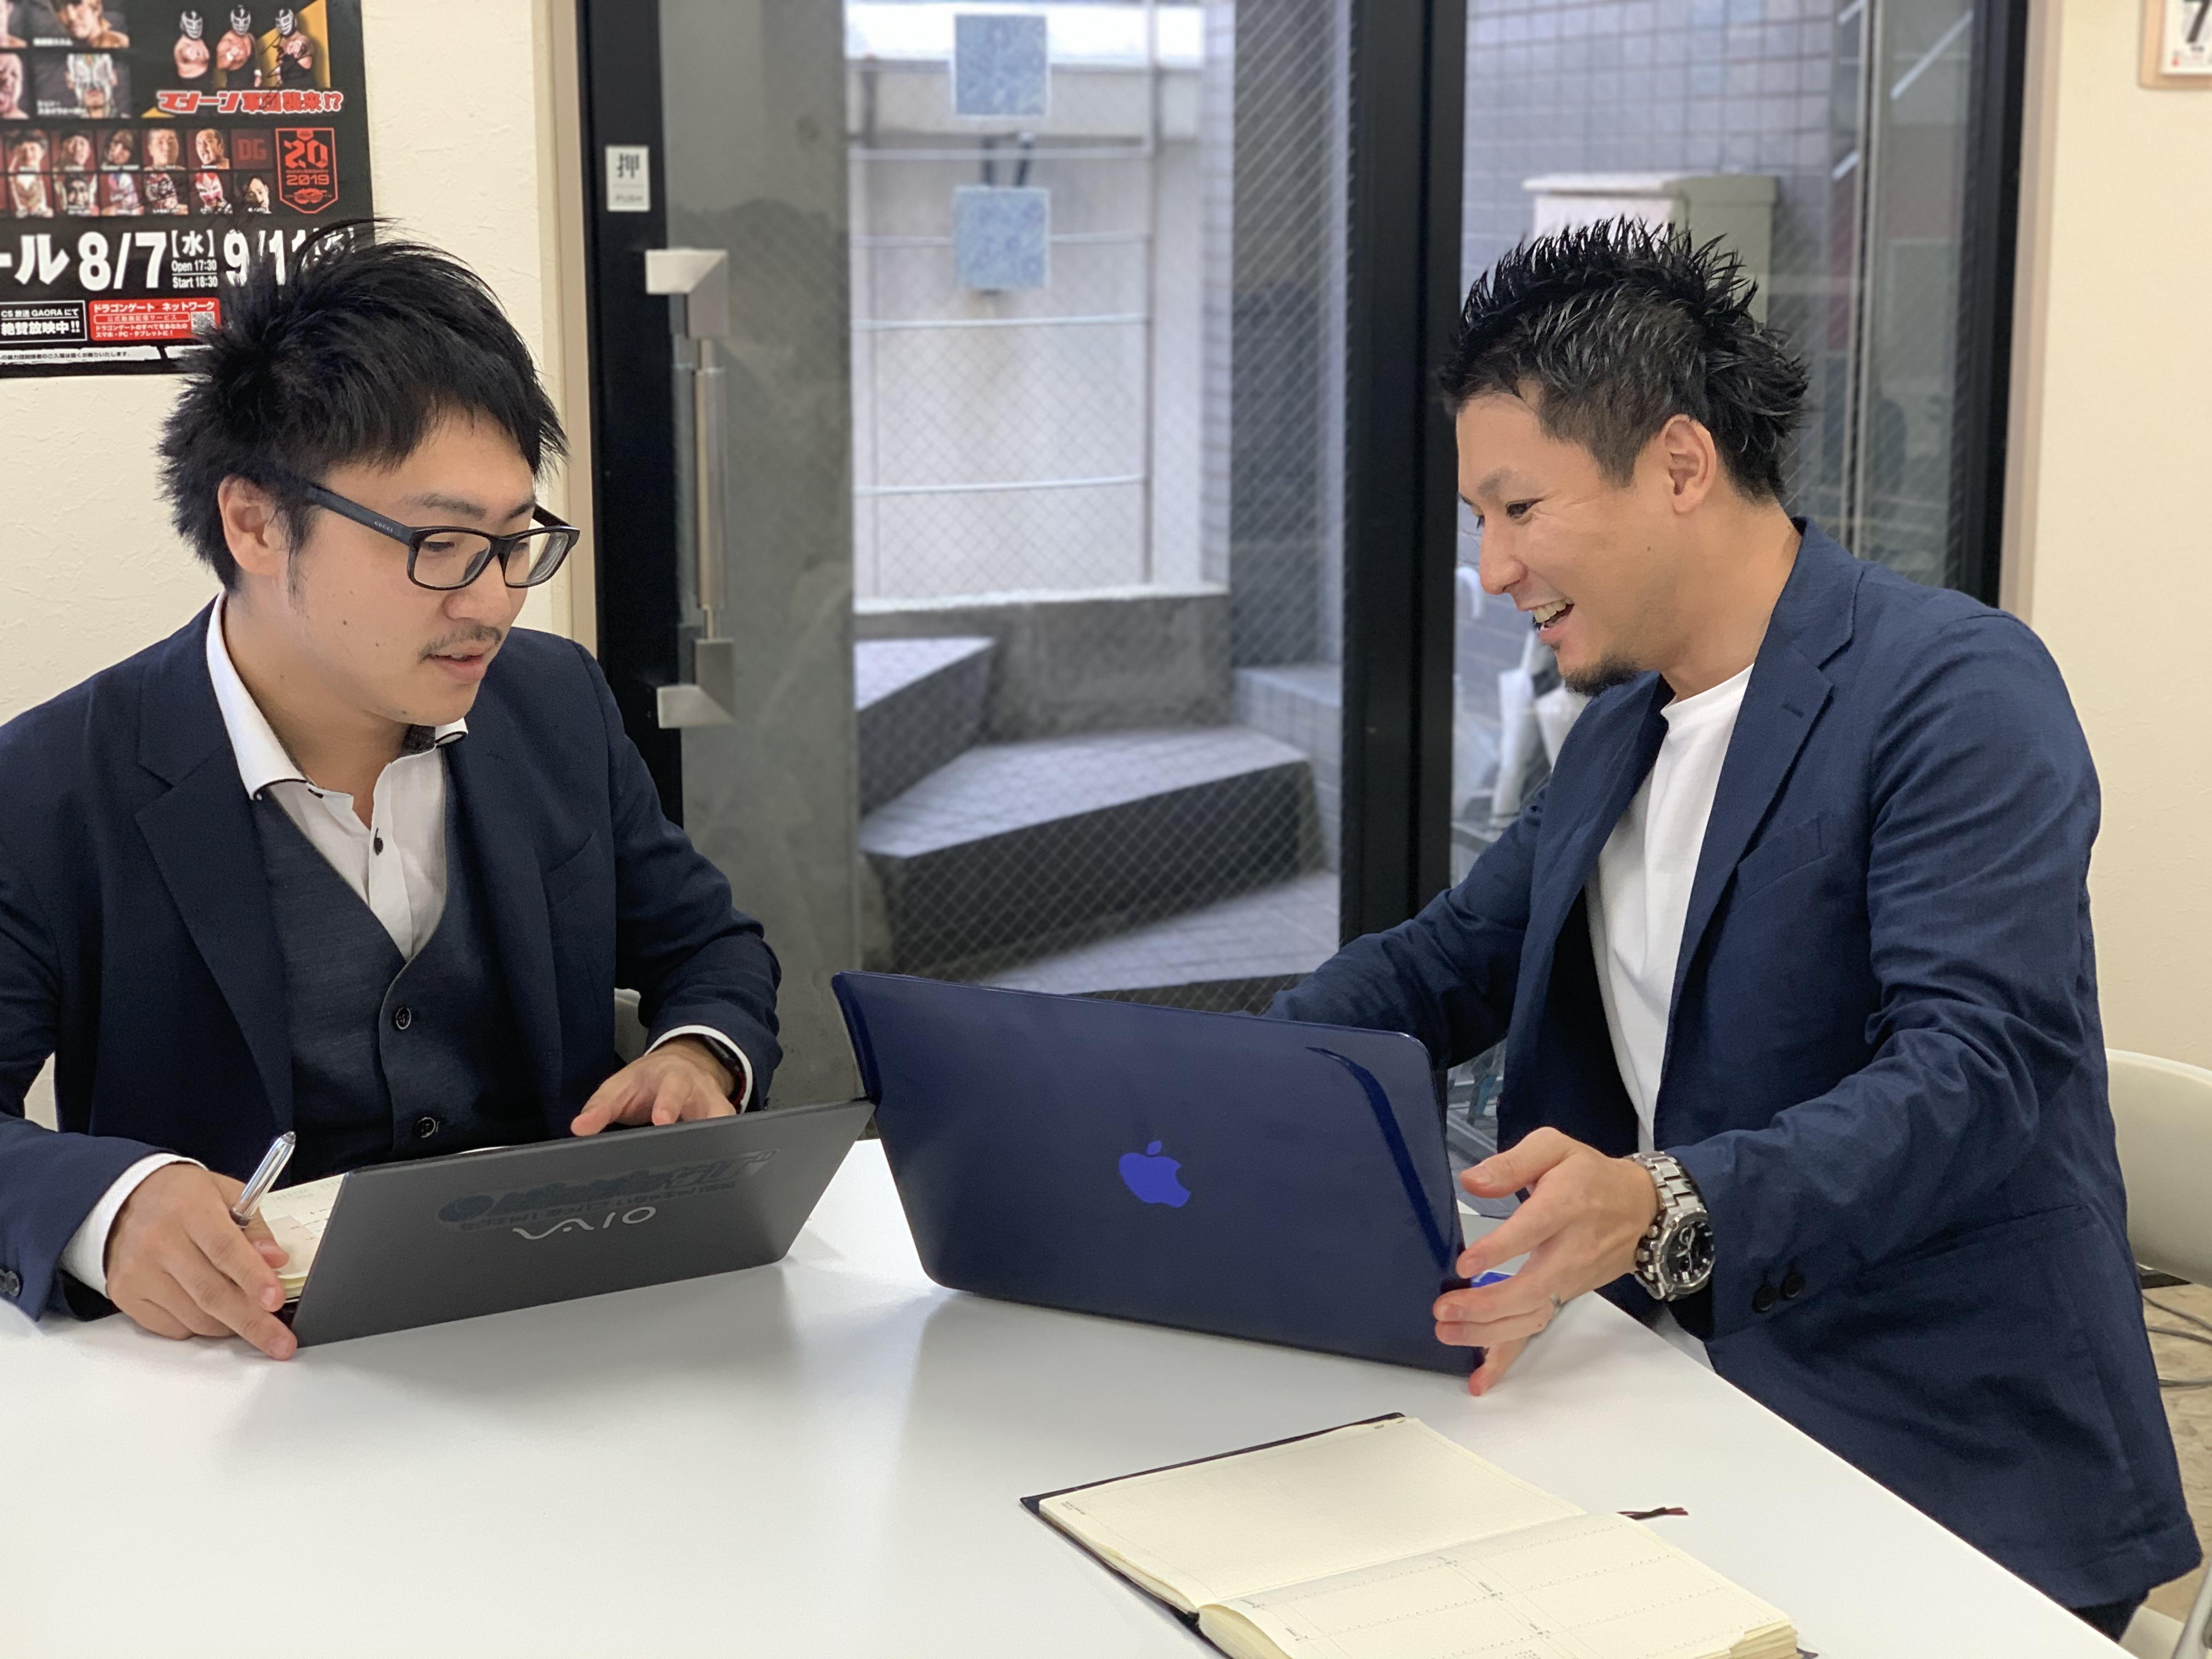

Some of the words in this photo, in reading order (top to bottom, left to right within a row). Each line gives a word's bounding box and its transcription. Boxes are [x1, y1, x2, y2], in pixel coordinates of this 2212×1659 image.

[238, 139, 267, 160] DG
[616, 153, 640, 179] 押
[286, 174, 329, 186] 2019
[0, 234, 70, 285] ル
[78, 231, 166, 291] 8/7
[172, 261, 192, 273] Open
[194, 259, 217, 272] 17:30
[172, 277, 194, 289] Start
[195, 276, 218, 288] 18:30
[162, 301, 215, 311] ネットワーク
[512, 1206, 657, 1240] VAIO
